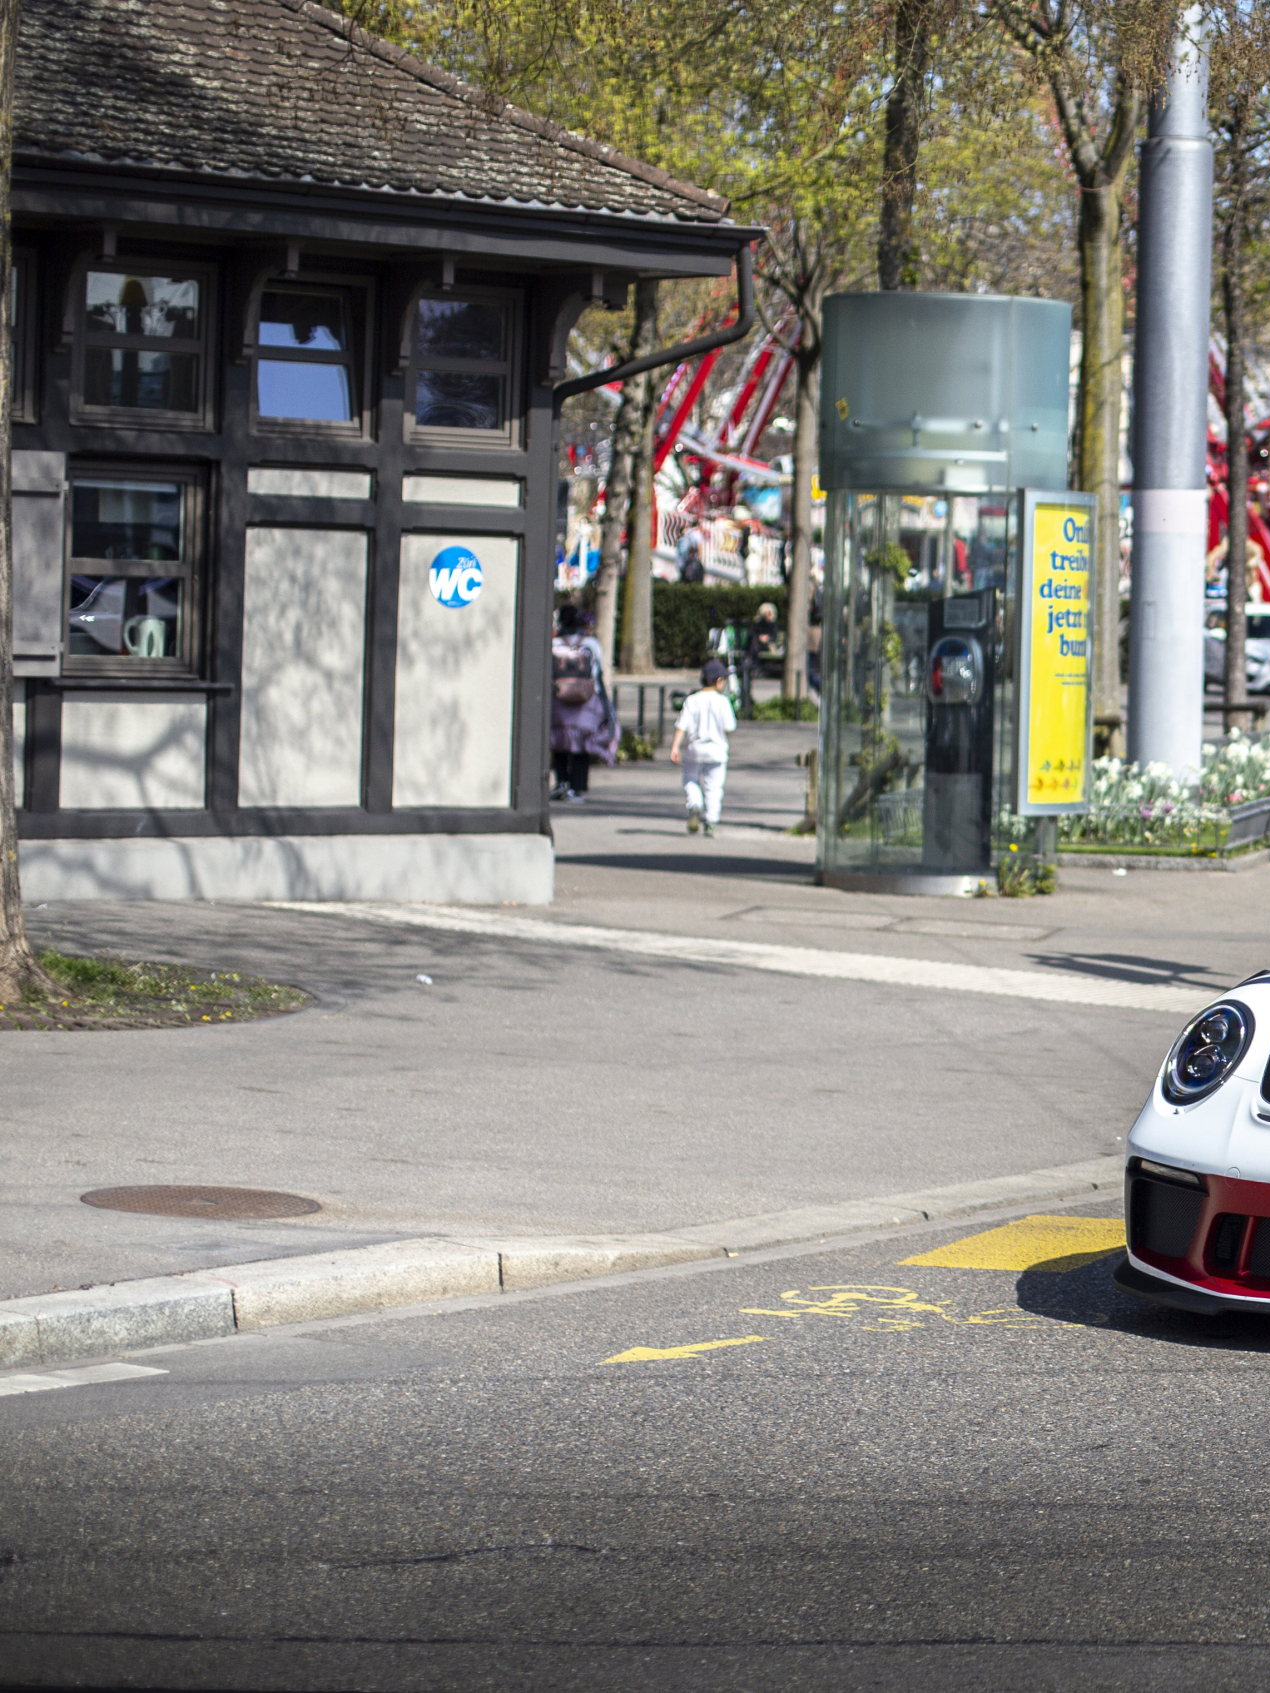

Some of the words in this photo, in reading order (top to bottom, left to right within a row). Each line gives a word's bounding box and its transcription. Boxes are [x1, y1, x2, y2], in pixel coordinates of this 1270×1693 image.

[429, 568, 483, 601] WC
[1039, 578, 1081, 600] deine
[1047, 605, 1081, 633] jetzt
